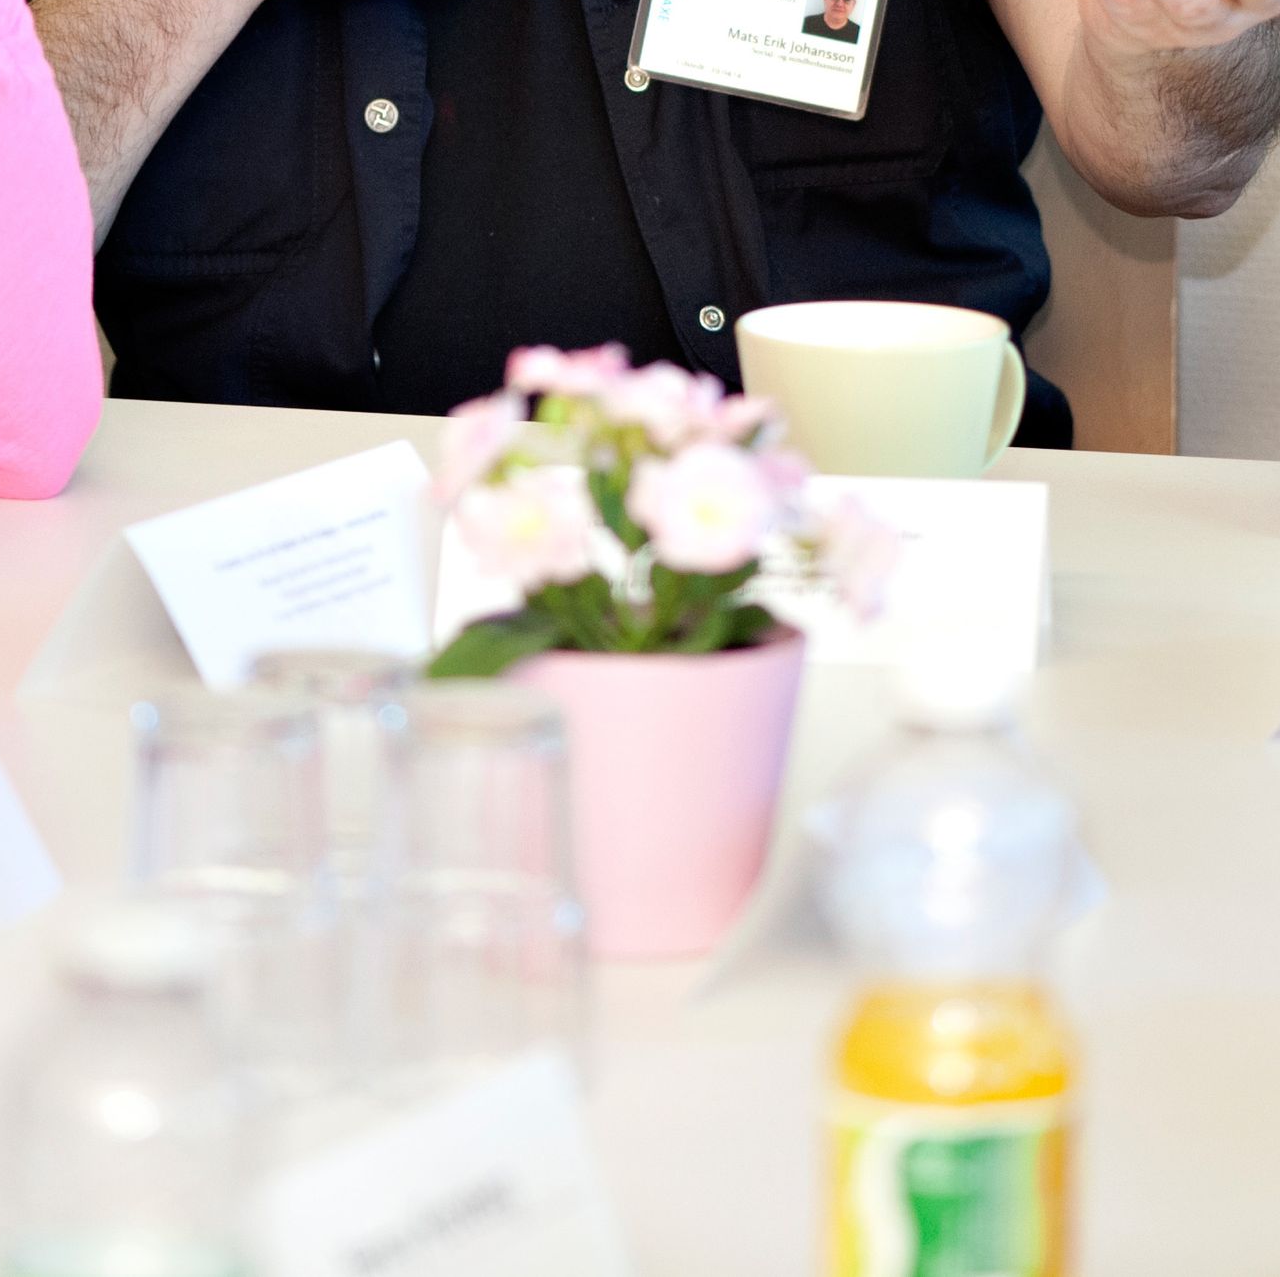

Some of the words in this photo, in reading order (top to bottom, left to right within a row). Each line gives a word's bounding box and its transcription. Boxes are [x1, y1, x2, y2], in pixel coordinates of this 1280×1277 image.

[728, 27, 759, 44] Mats
[763, 35, 787, 50] Erik
[790, 41, 856, 64] Johansson
